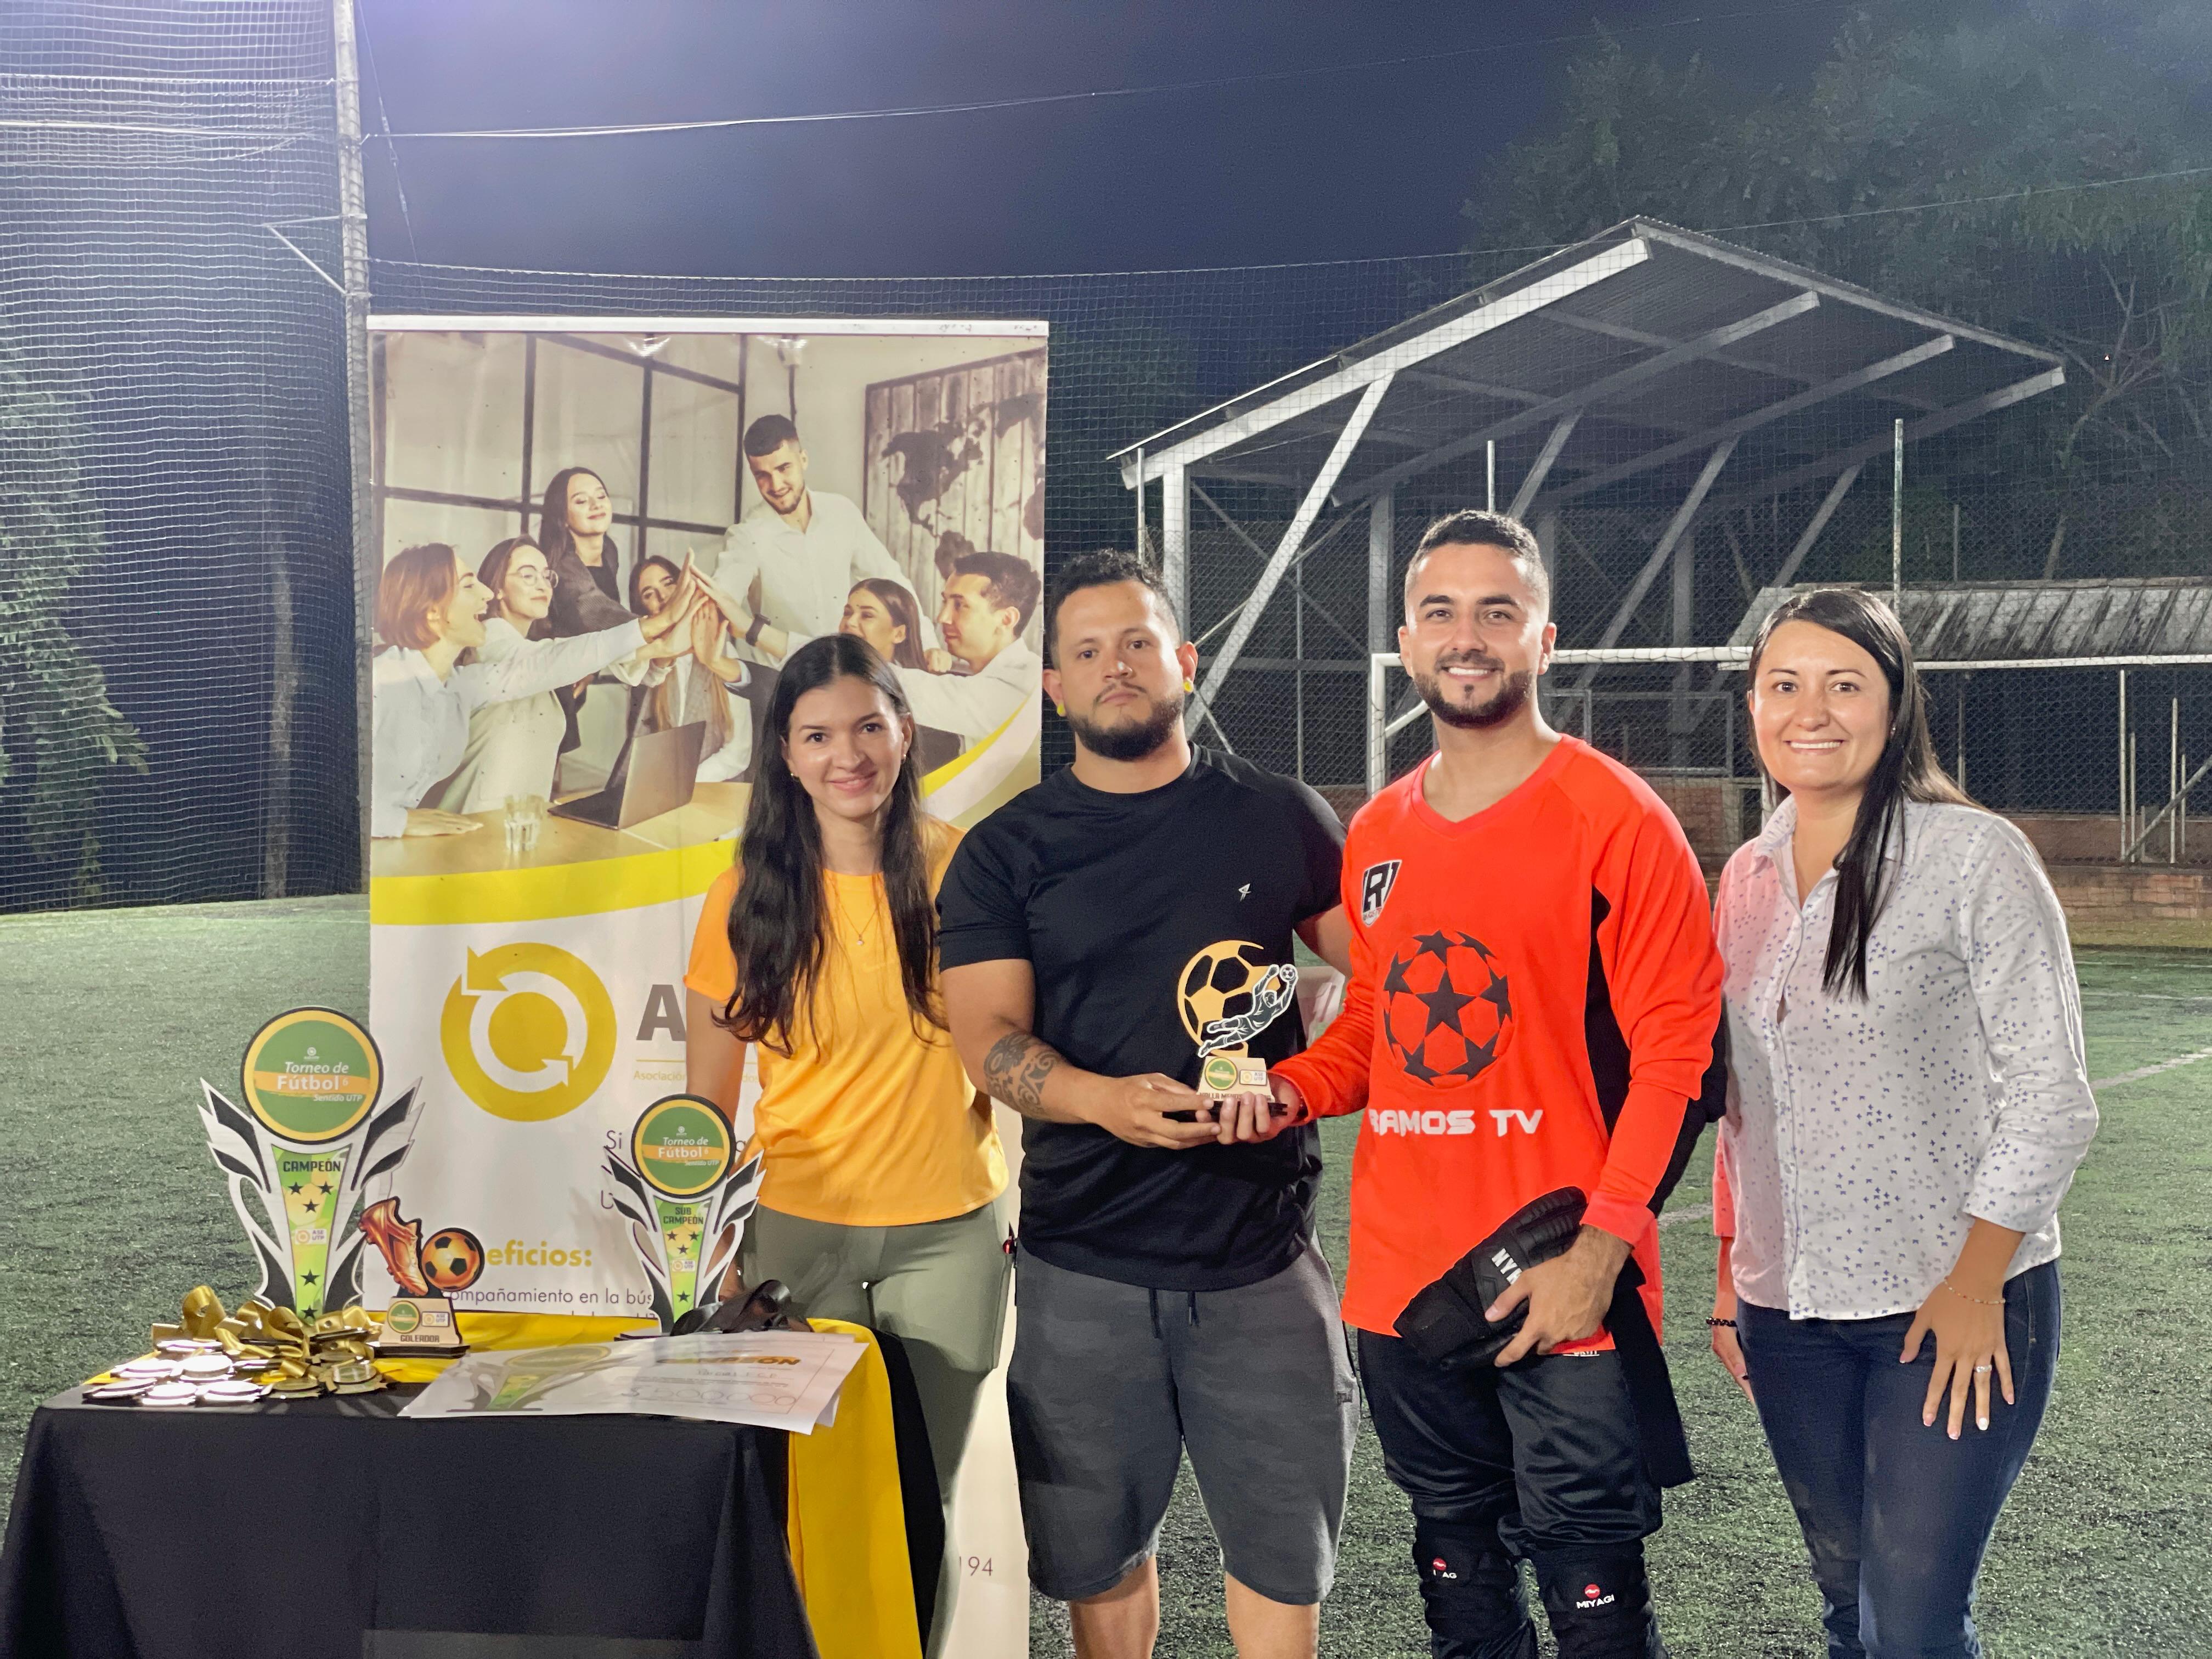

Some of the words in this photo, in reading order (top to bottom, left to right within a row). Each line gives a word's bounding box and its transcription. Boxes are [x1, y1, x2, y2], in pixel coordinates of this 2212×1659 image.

[285, 1062, 330, 1073] Torneo
[332, 1062, 349, 1073] de
[278, 1075, 339, 1090] Fútbol
[1368, 1108, 1476, 1137] RAMOS
[1489, 1109, 1543, 1137] TV
[606, 1130, 623, 1149] Si
[663, 1137, 695, 1146] Torneo
[697, 1136, 709, 1146] de
[658, 1146, 702, 1158] Fútbol
[486, 1240, 592, 1267] eficios:
[450, 1288, 573, 1306] ompañamiento
[579, 1293, 598, 1304] en
[606, 1288, 619, 1304] la
[1576, 1594, 1615, 1609] MIYAGI
